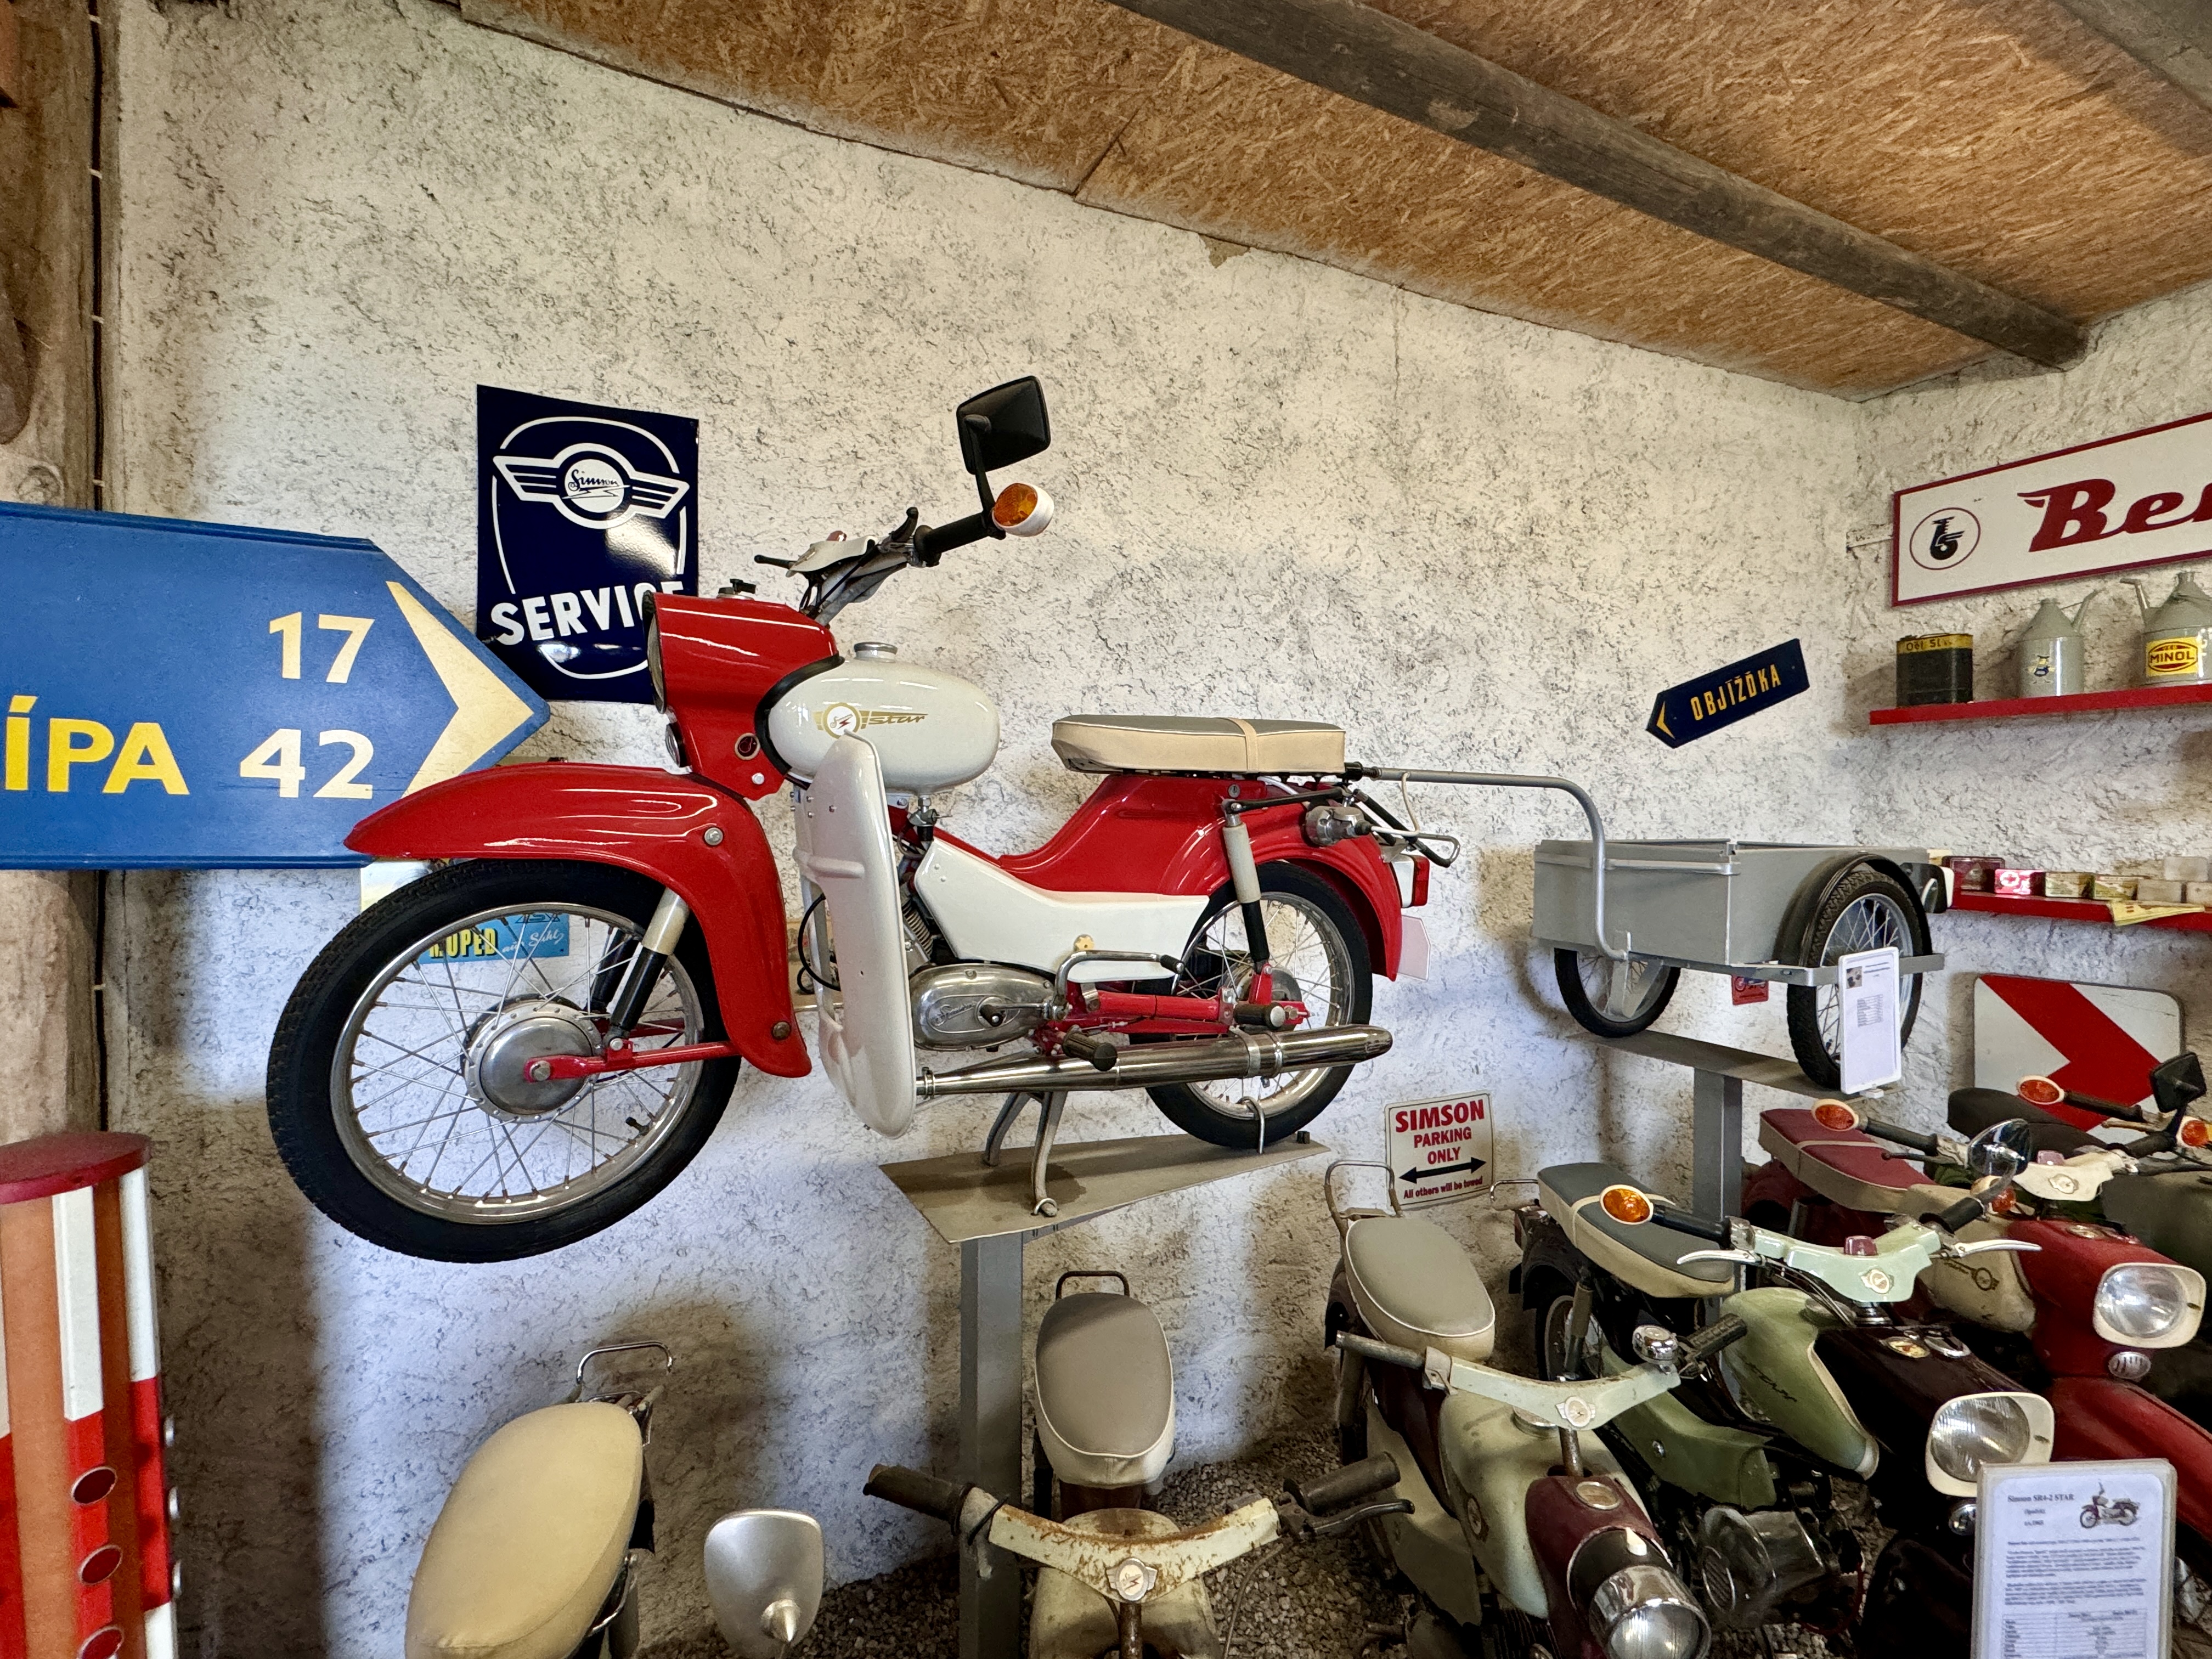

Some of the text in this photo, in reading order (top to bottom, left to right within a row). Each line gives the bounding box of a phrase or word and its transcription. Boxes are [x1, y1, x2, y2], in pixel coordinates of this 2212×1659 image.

[269, 611, 375, 684] 17
[2150, 651, 2195, 664] MINOL
[240, 729, 374, 799] 42
[1395, 1099, 1485, 1133] SIMSON
[1414, 1126, 1472, 1148] PARKING
[1427, 1147, 1461, 1165] ONLY
[1403, 1175, 1483, 1199] All others will be towed
